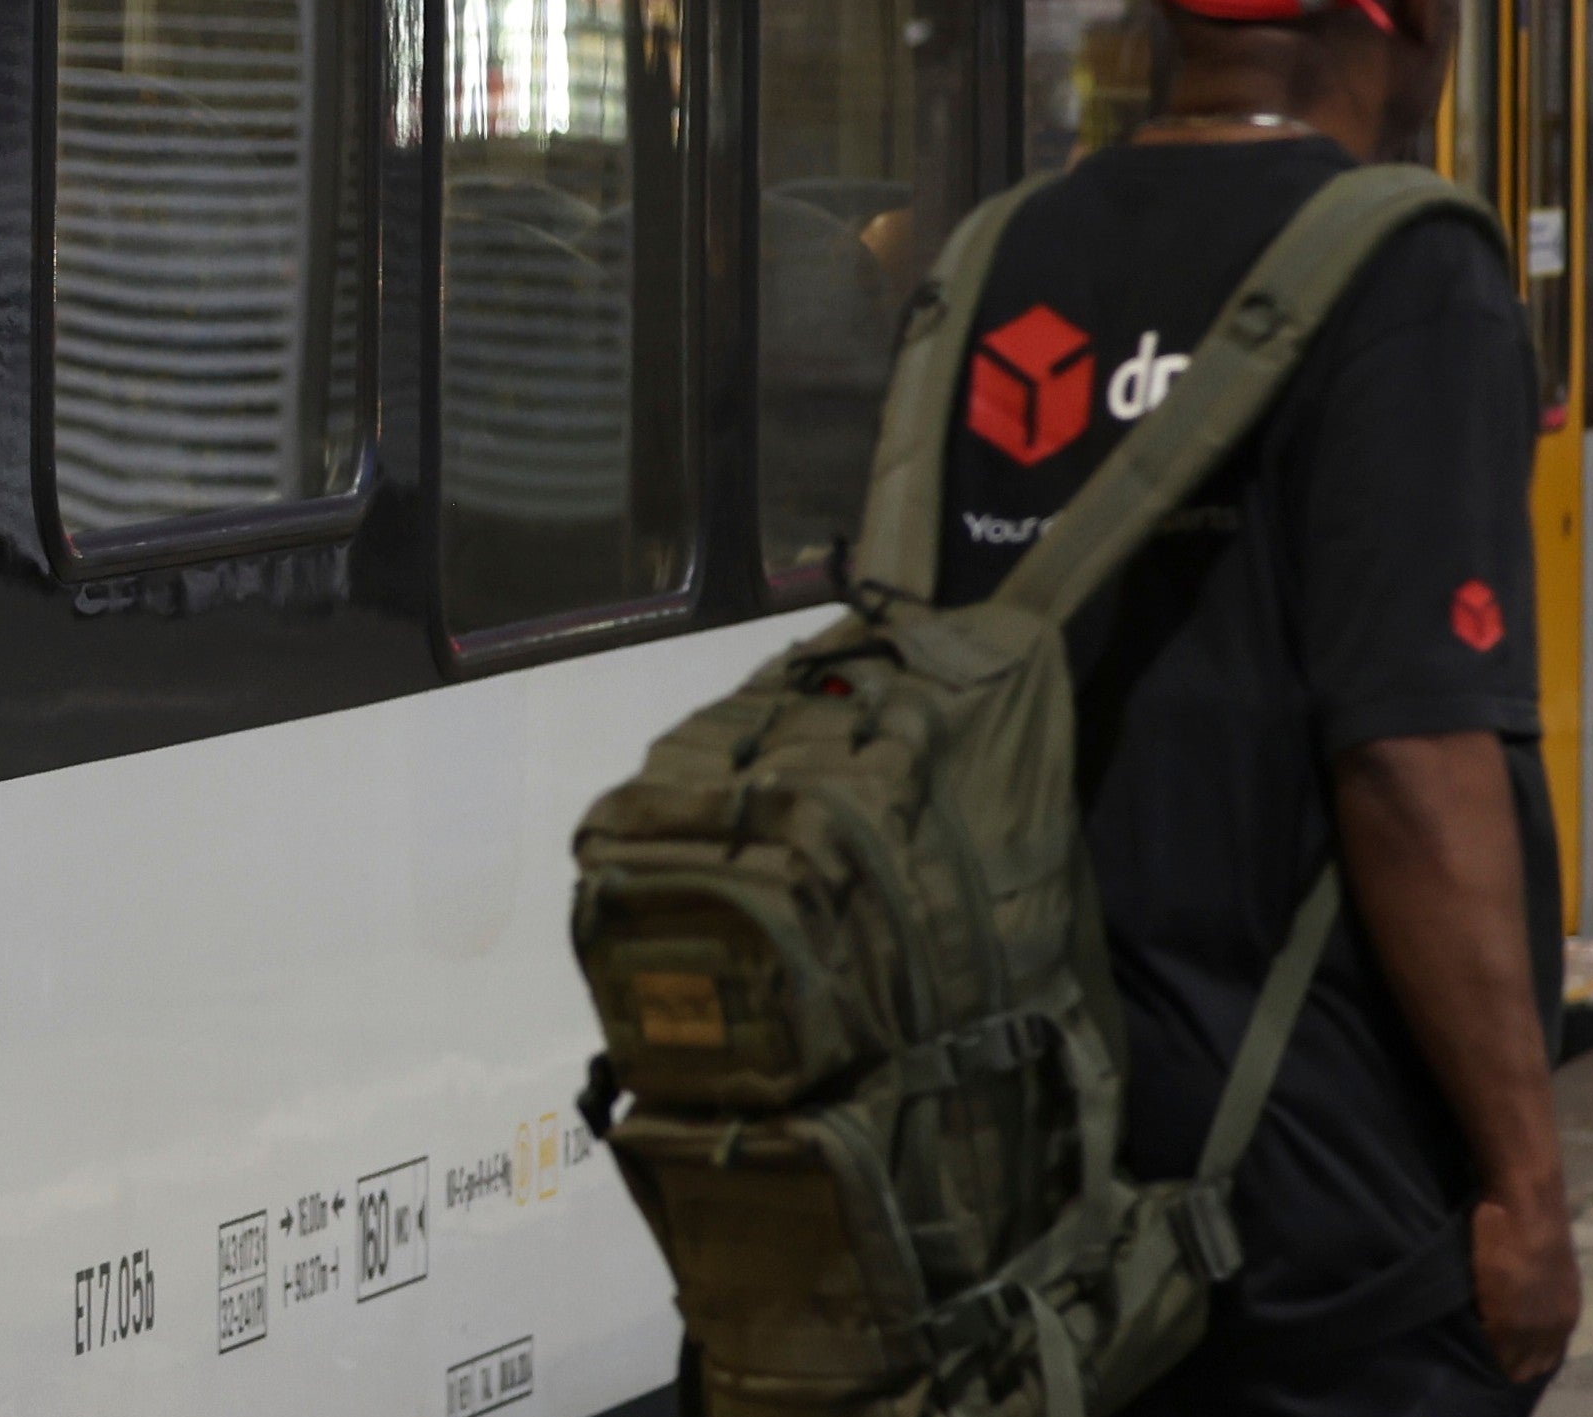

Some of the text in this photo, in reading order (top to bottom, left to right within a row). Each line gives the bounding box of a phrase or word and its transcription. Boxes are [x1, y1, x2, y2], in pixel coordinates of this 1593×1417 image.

[358, 1190, 390, 1281] 160
[74, 1249, 155, 1356] ET 7.05b
